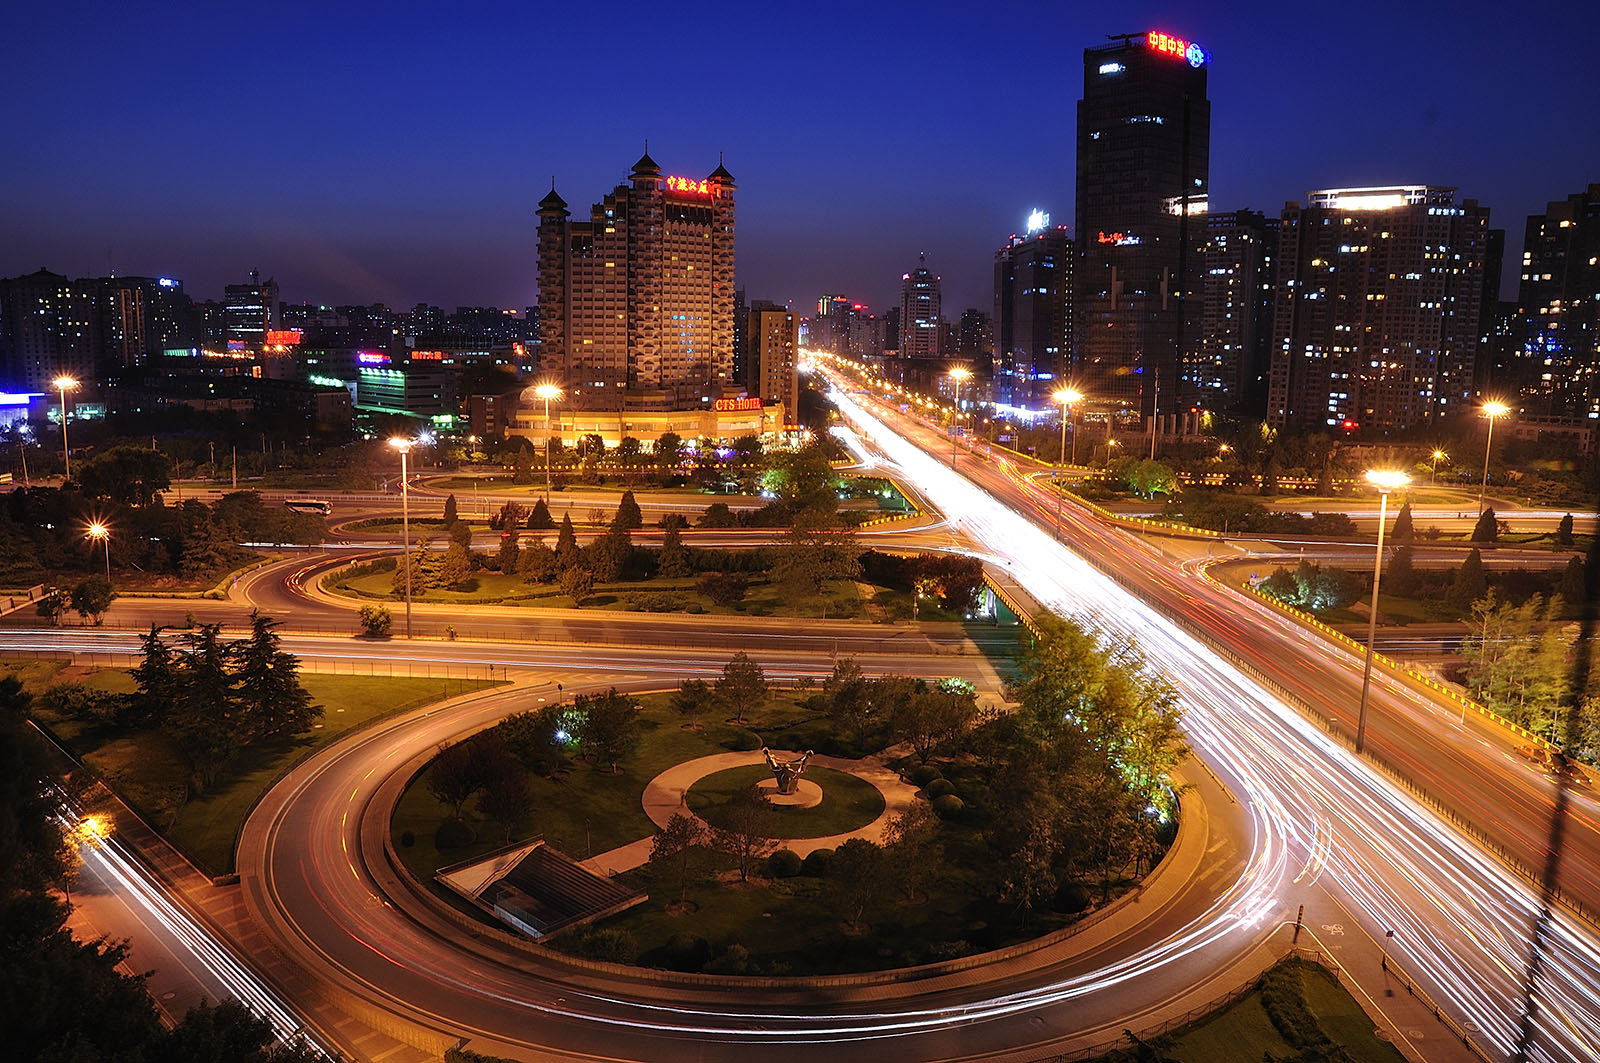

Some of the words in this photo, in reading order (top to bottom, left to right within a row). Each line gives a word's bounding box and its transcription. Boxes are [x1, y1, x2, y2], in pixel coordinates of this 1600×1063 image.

[1149, 31, 1185, 58] 中国中冶
[715, 399, 735, 410] CTS
[738, 398, 760, 410] HOTEL
